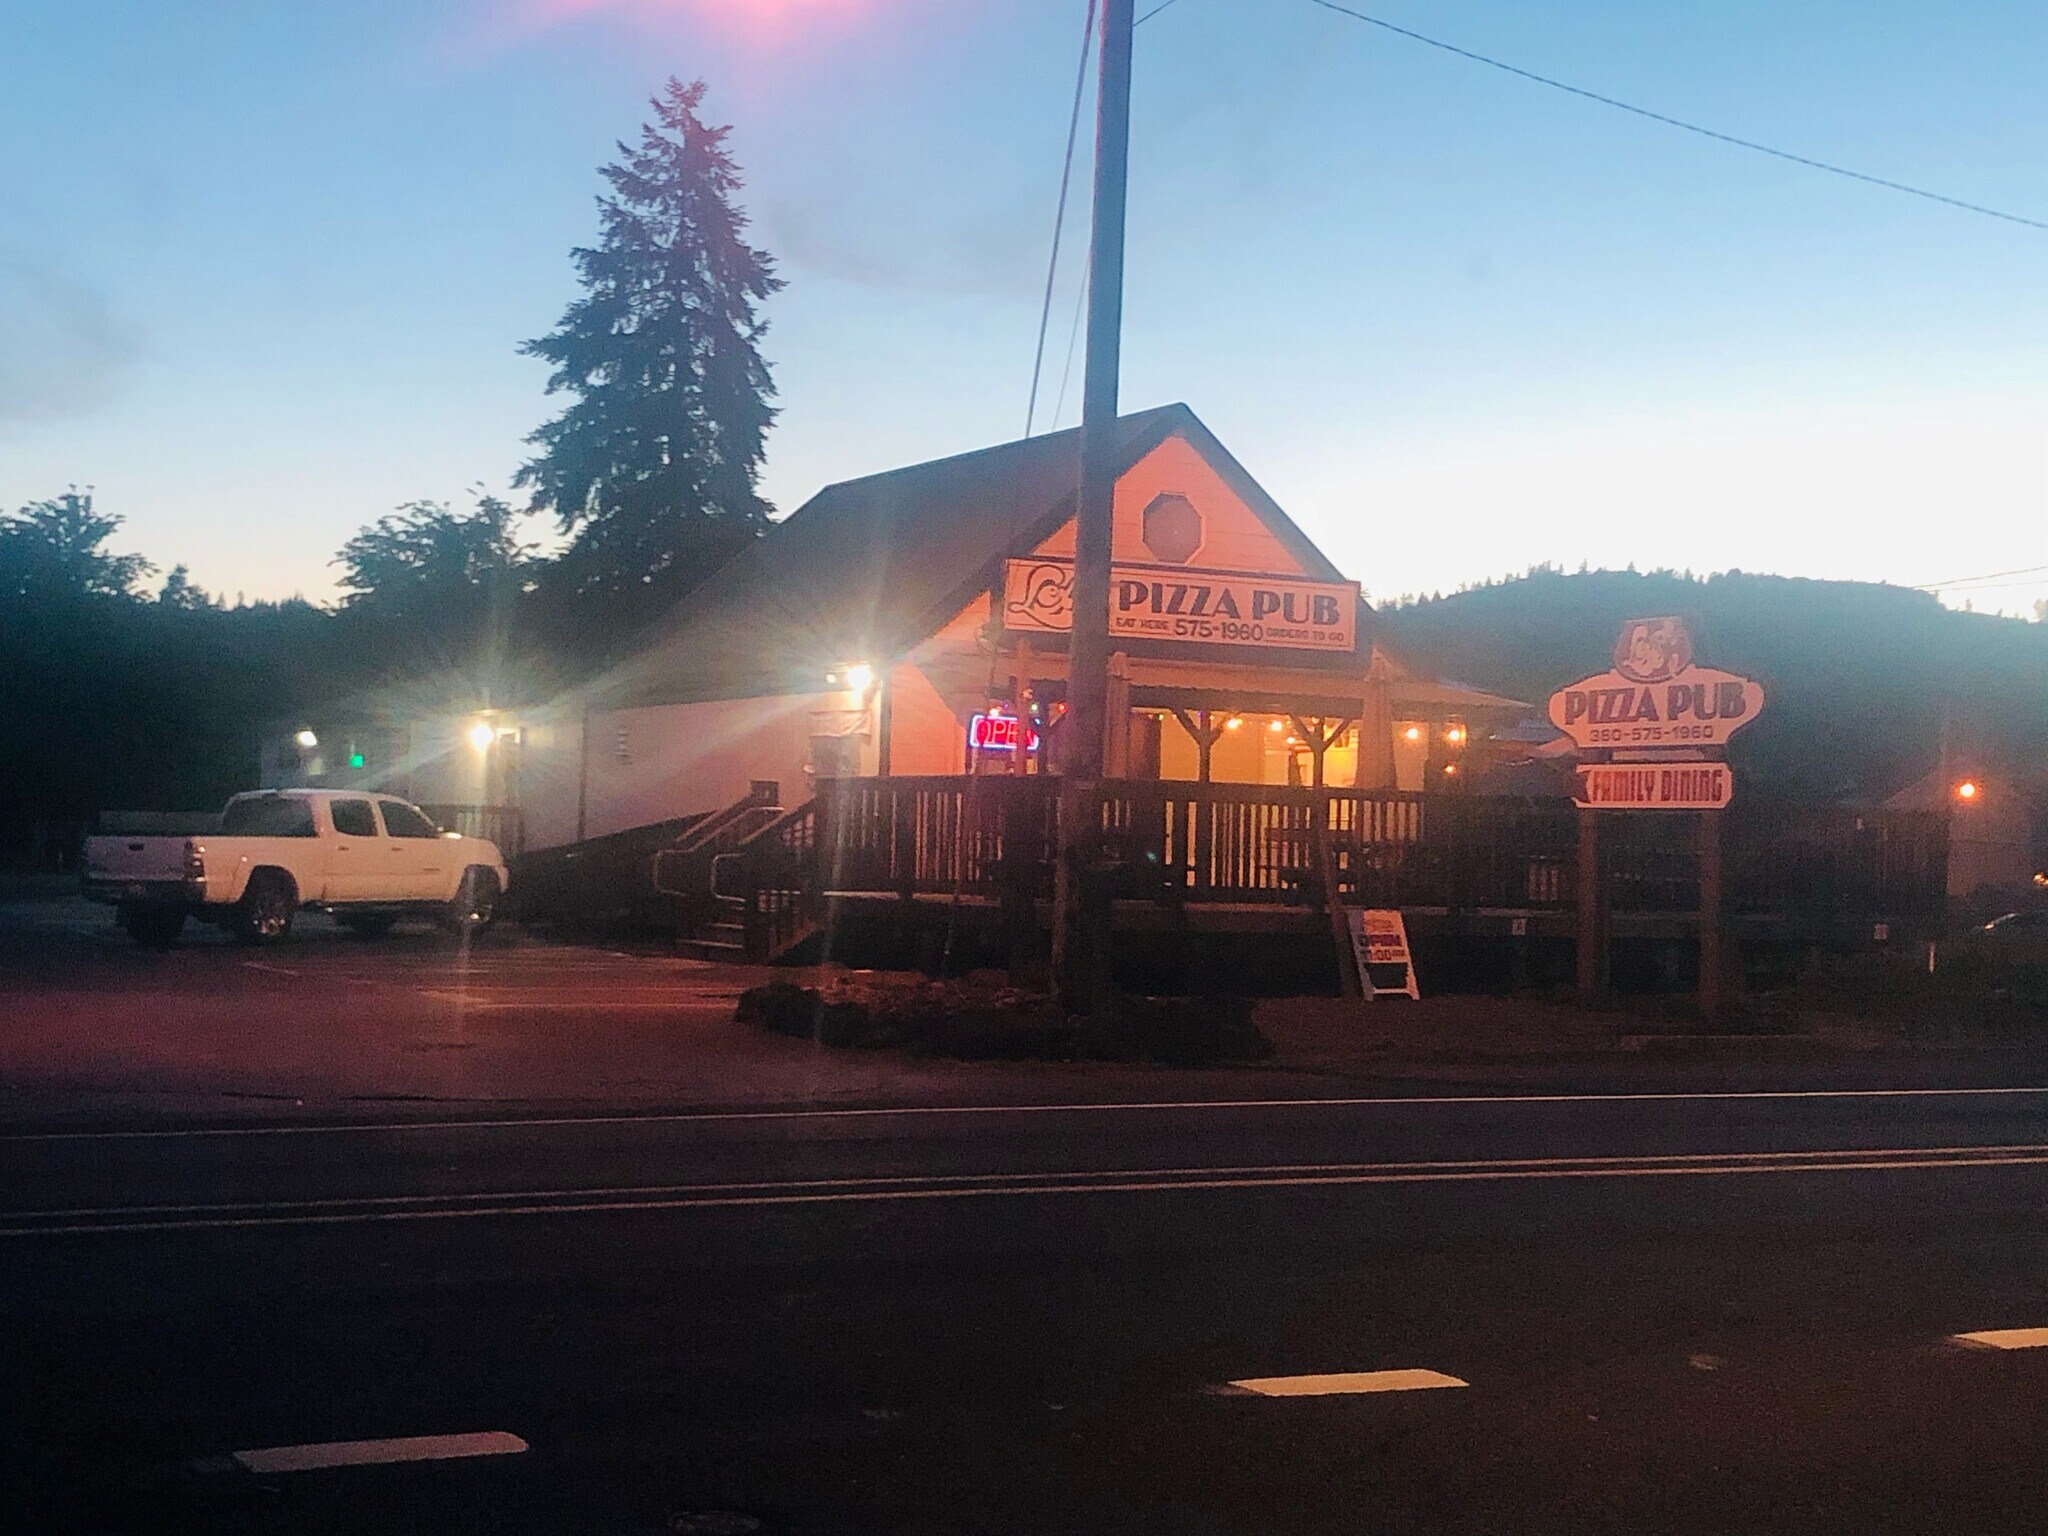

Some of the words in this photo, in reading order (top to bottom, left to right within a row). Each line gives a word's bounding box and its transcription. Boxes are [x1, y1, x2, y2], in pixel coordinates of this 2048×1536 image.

[1119, 580, 1241, 619] PIZZA
[1252, 589, 1340, 626] PUB
[1173, 618, 1264, 641] 575-1960
[1312, 630, 1326, 640] TO
[1565, 686, 1660, 725] PIZZA
[1667, 682, 1746, 720] PUB
[1591, 770, 1655, 802] FAMILY
[1661, 769, 1723, 802] DINING
